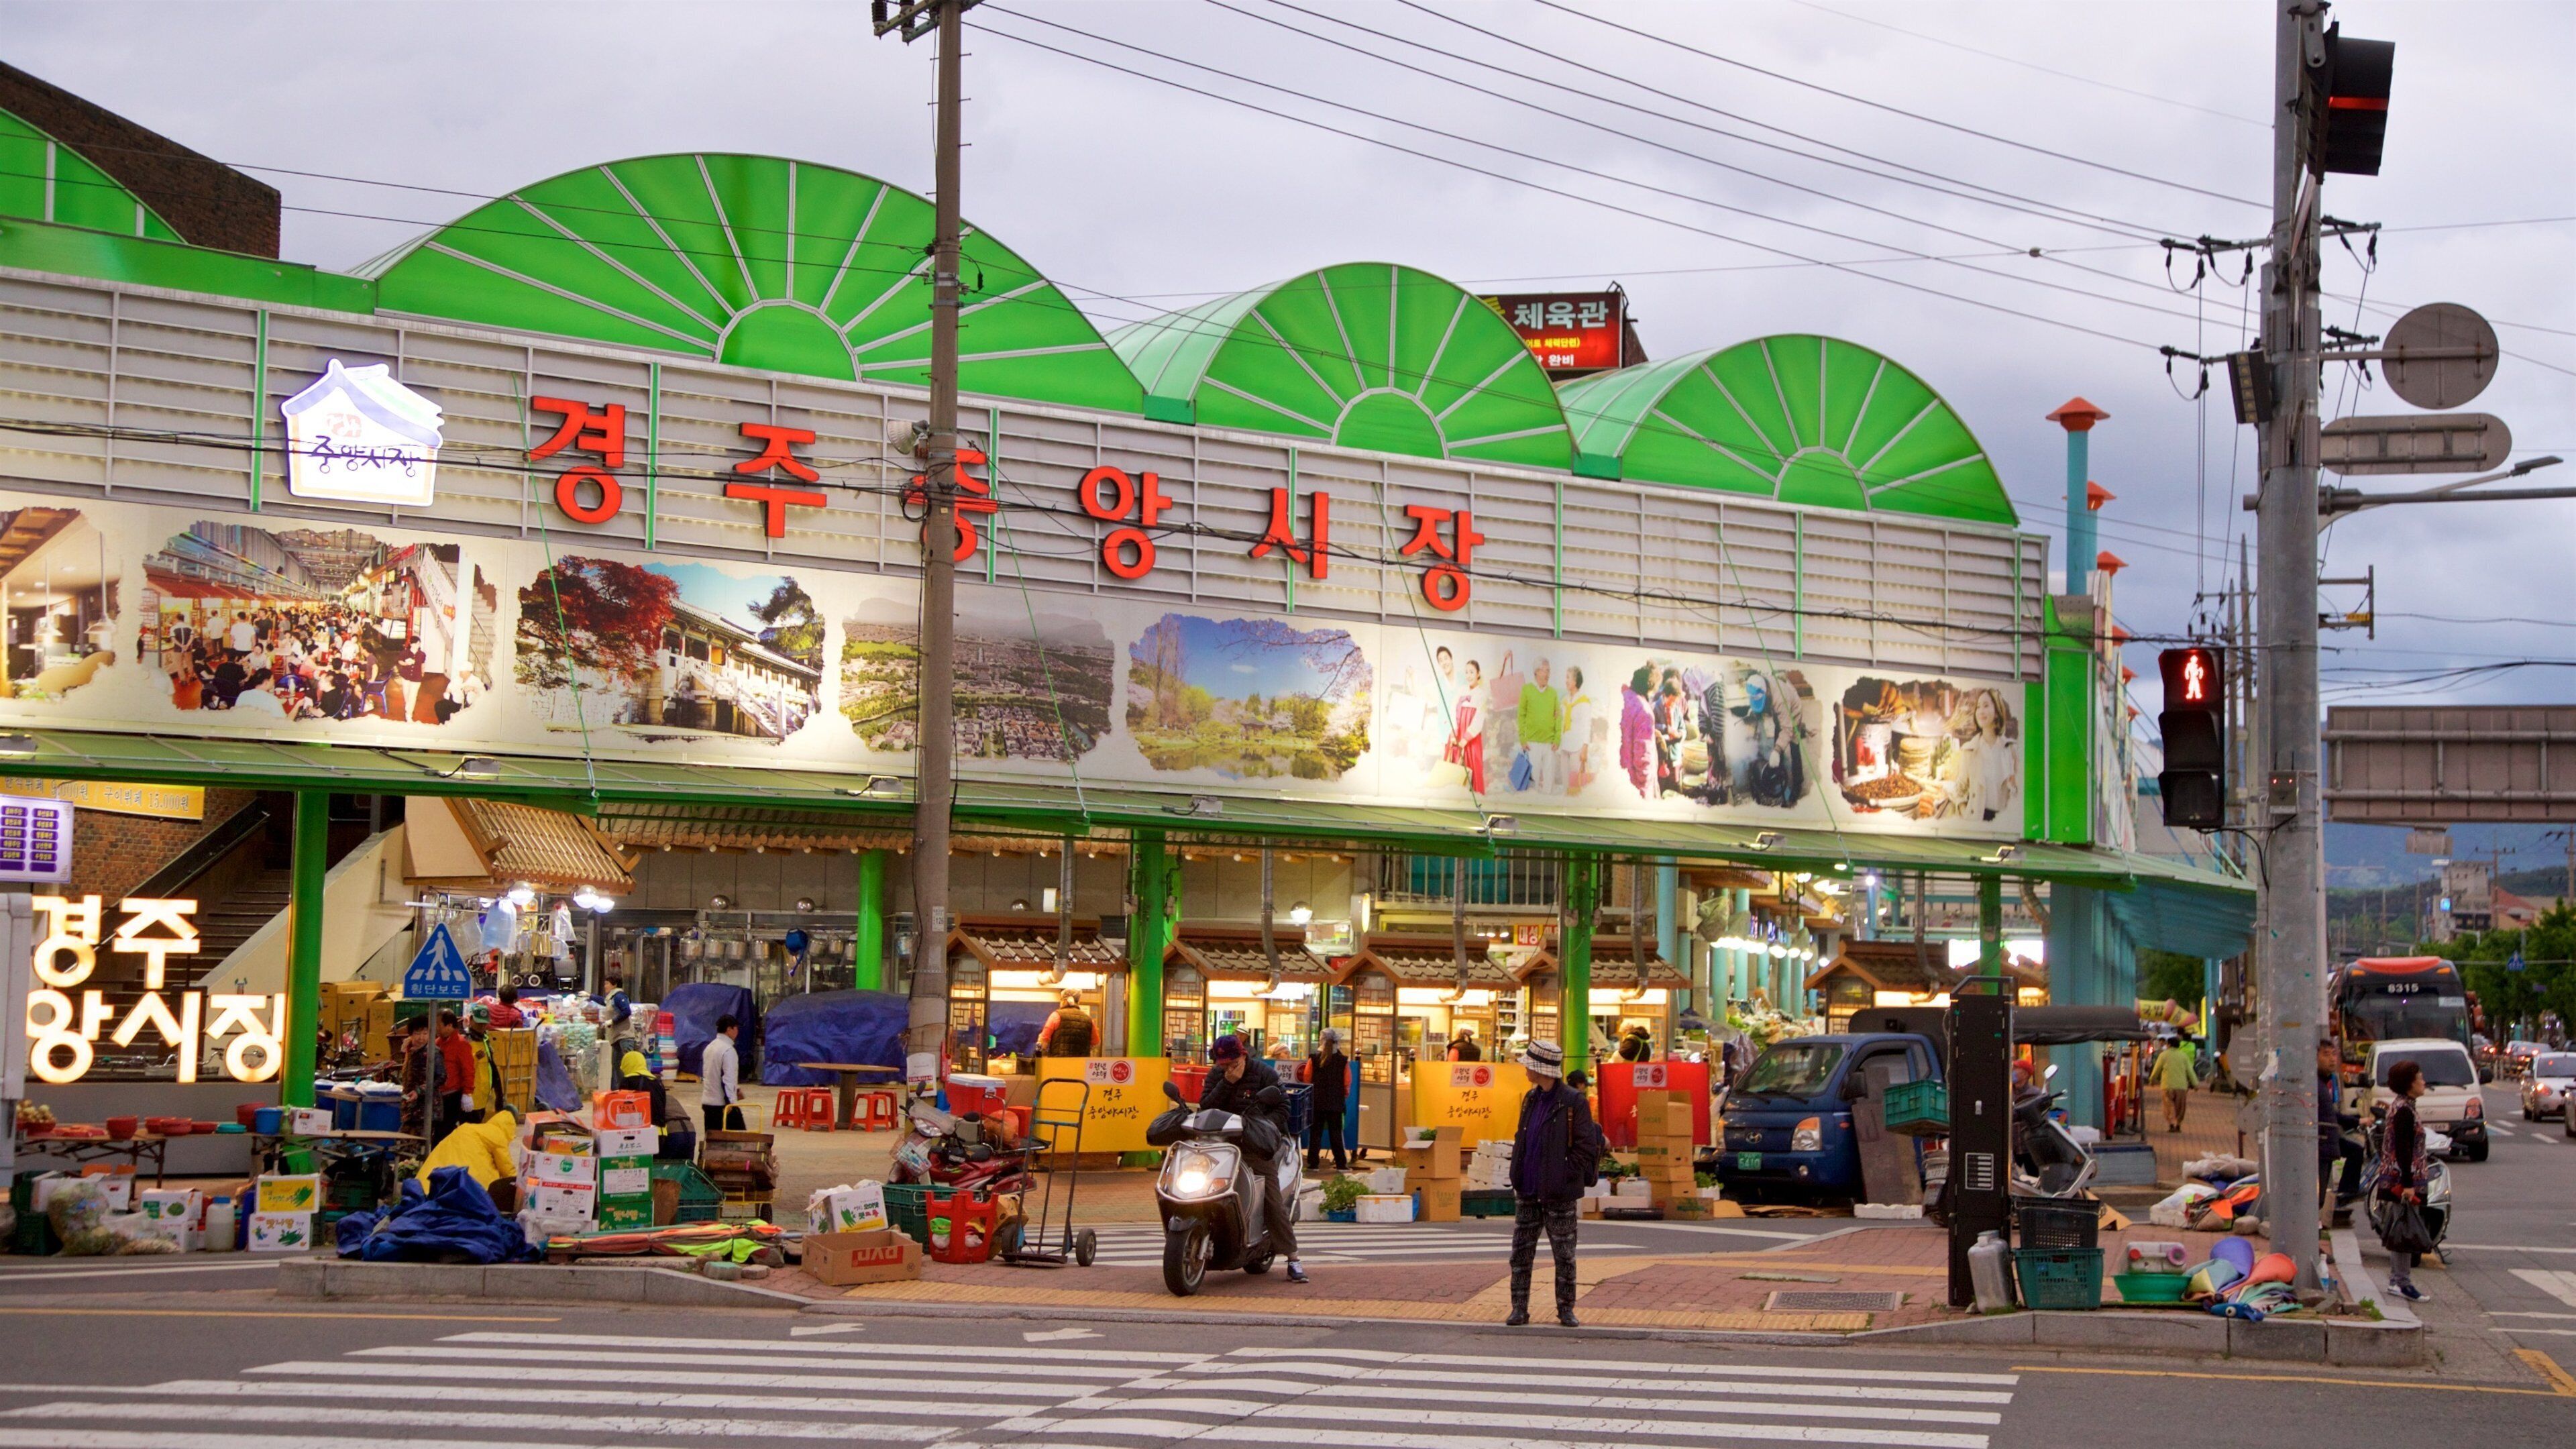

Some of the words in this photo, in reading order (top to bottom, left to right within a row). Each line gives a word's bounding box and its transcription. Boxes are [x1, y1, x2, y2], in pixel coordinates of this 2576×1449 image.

[1514, 301, 1609, 329] 체육관
[1548, 354, 1574, 366] 완비
[311, 435, 422, 478] 중앙시장
[32, 895, 200, 989] 경주
[411, 983, 463, 994] 횡단보도
[1103, 1087, 1122, 1102] 경주
[1462, 1089, 1479, 1102] 경주
[1087, 1105, 1139, 1119] 중앙야시장
[1447, 1106, 1492, 1119] 중앙야시장
